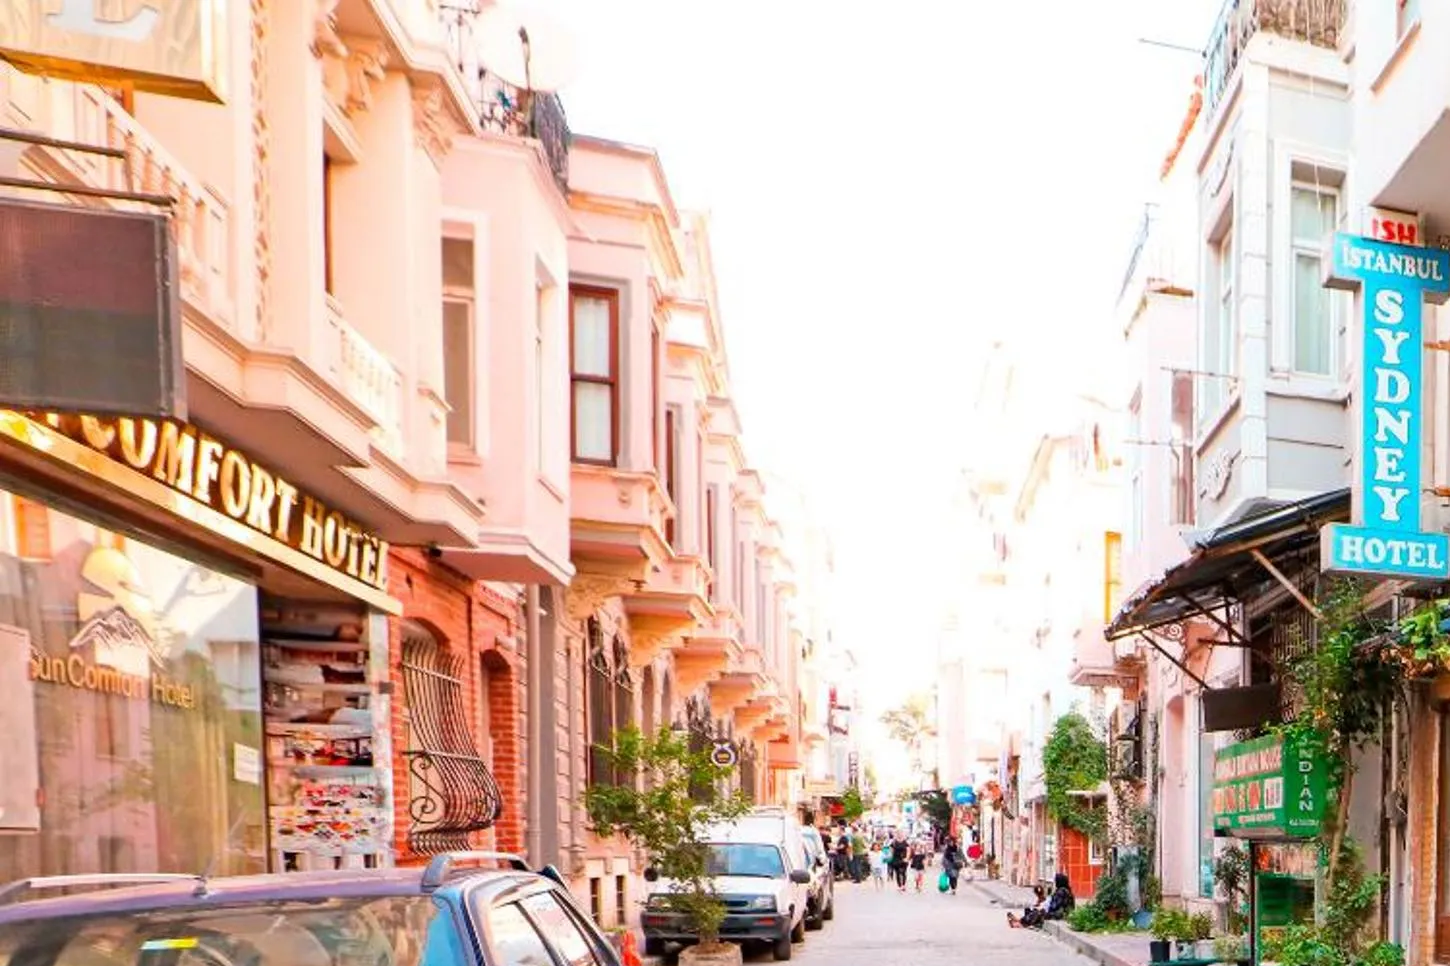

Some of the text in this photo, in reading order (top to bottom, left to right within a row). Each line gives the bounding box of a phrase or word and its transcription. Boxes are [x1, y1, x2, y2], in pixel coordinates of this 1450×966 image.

[1374, 289, 1411, 521] SYDNEY
[300, 495, 390, 592] HOTEL
[1341, 534, 1445, 570] HOTEL
[152, 672, 195, 709] Hotel
[1298, 748, 1314, 812] NDIAN
